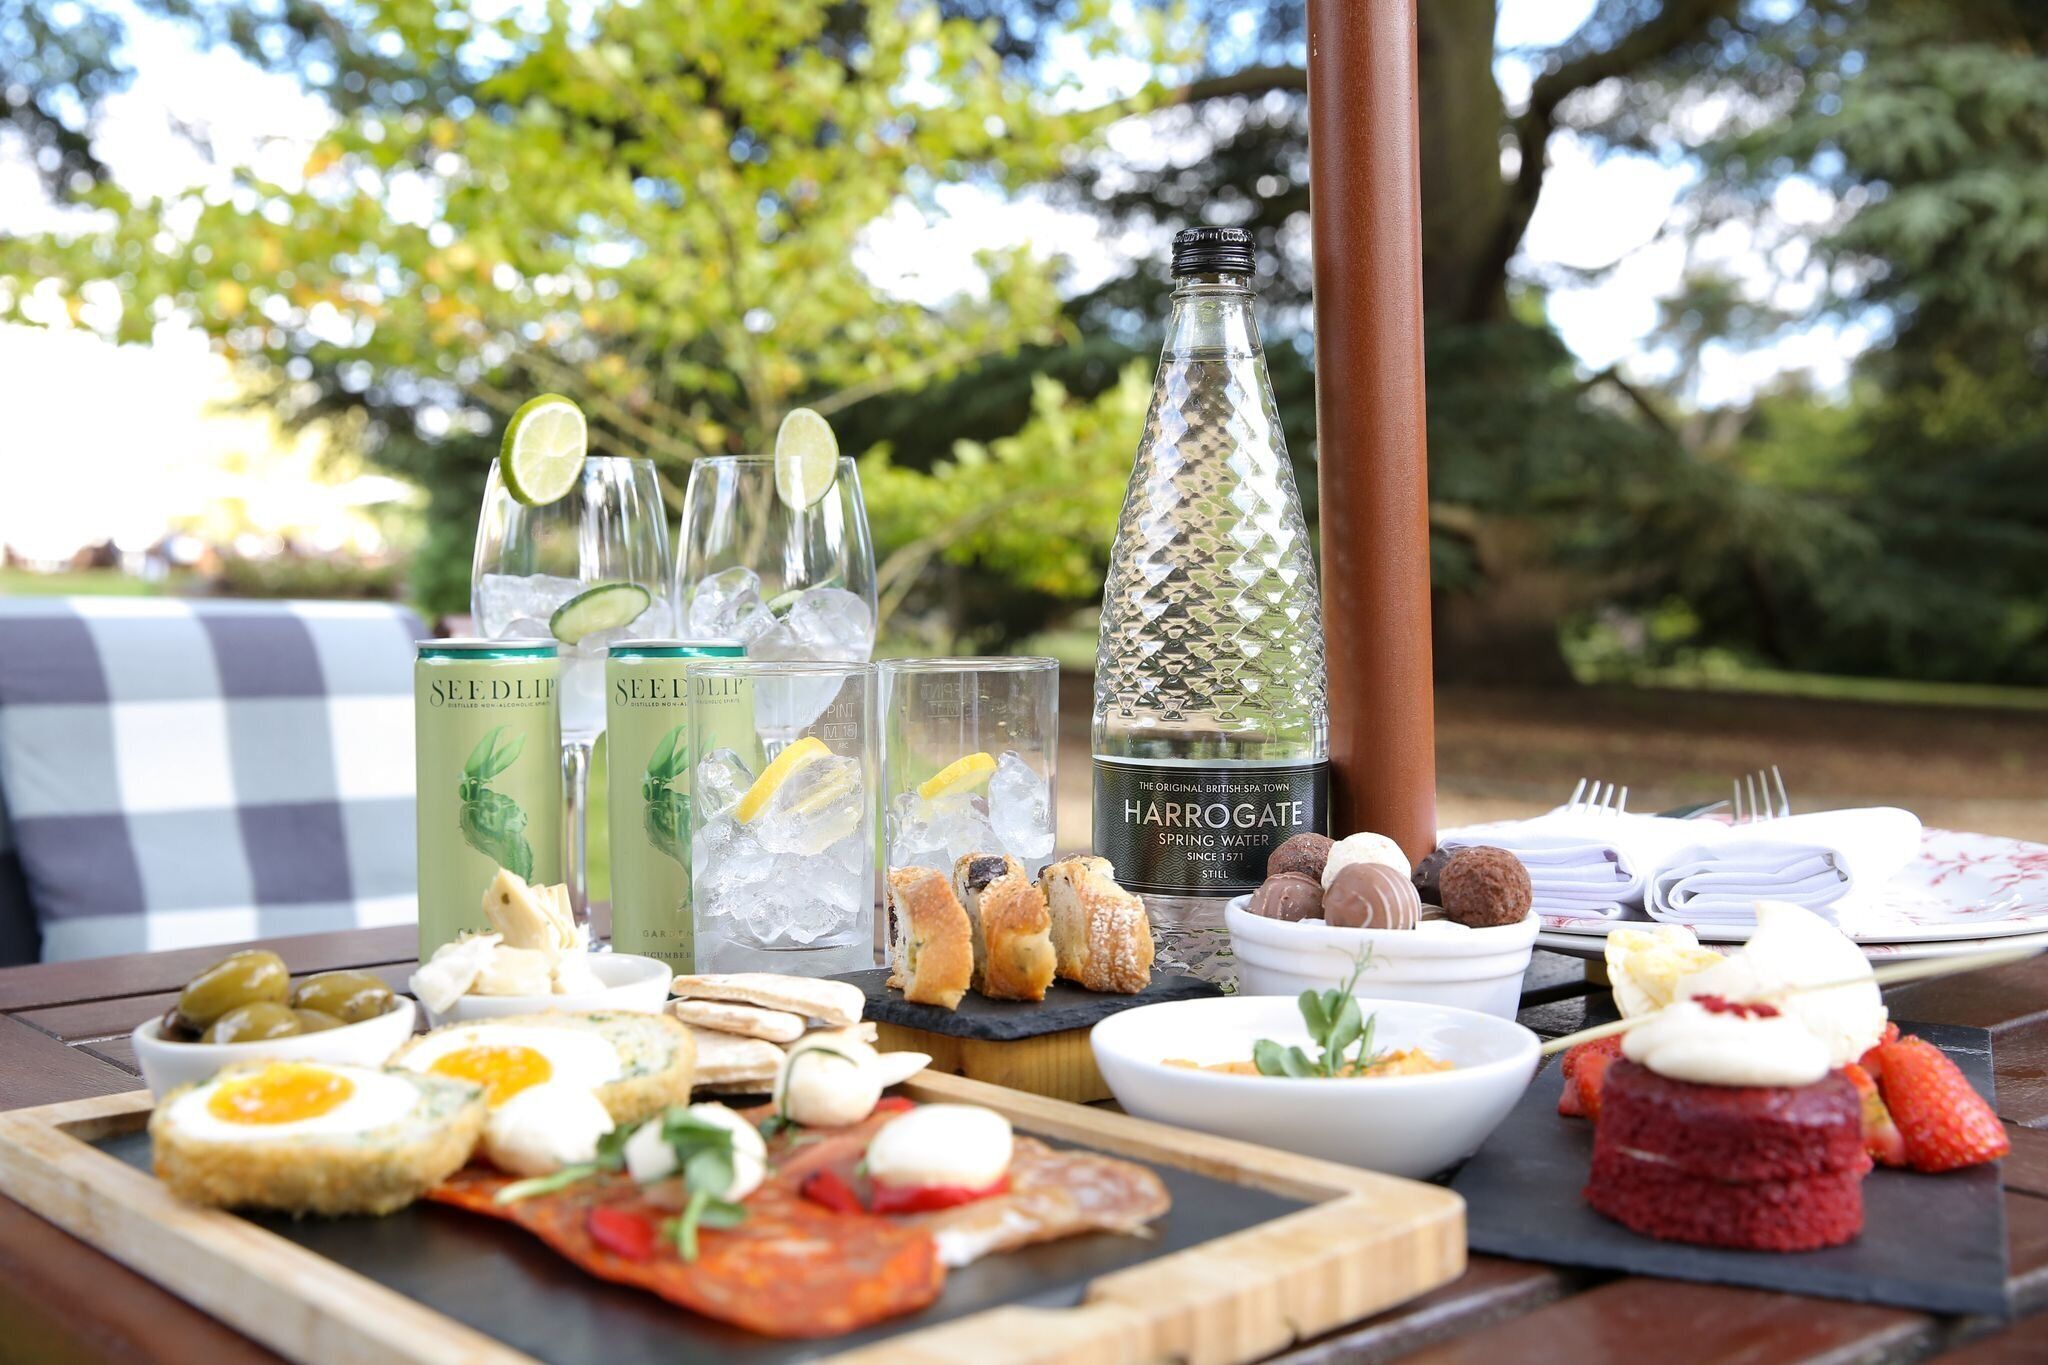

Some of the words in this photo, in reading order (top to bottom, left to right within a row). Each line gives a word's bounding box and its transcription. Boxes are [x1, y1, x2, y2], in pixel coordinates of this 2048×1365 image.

[430, 678, 555, 708] SEEDLIP
[1139, 781, 1154, 791] THE
[1155, 782, 1203, 793] ORIGINAL
[1206, 783, 1241, 793] BRITISH
[1243, 783, 1261, 792] SPA
[1263, 783, 1290, 792] TOWN
[1124, 798, 1304, 829] HARROGATE
[1158, 832, 1215, 847] SPRING
[1220, 833, 1270, 847] WATER
[1186, 851, 1217, 861] SINCE
[1220, 852, 1244, 862] 1571
[1201, 869, 1229, 879] STILL
